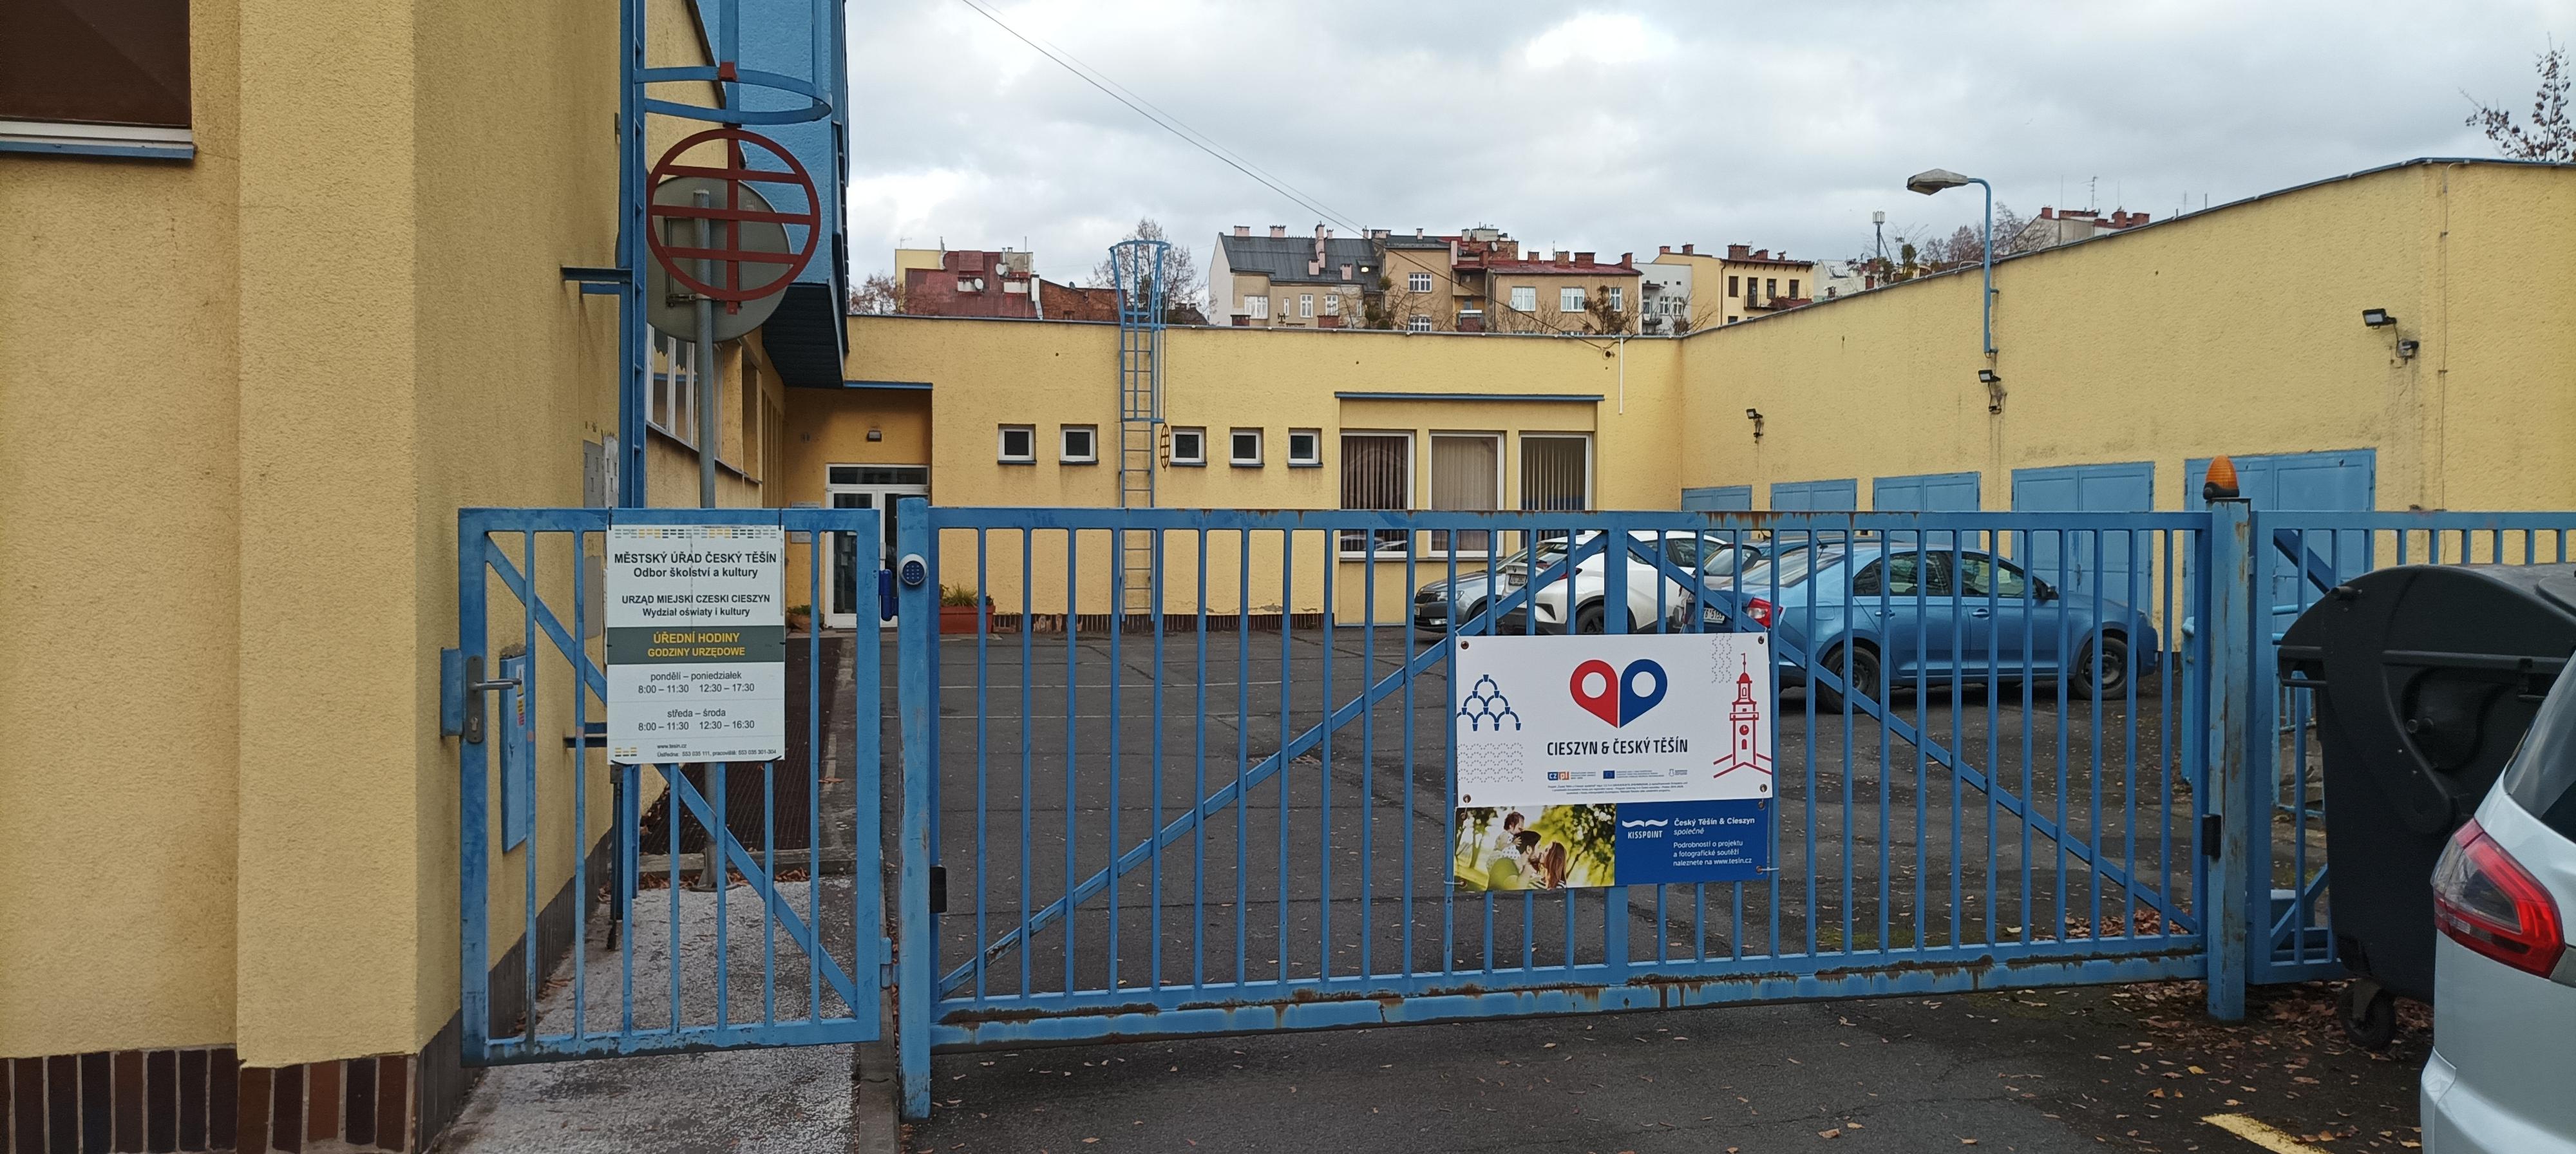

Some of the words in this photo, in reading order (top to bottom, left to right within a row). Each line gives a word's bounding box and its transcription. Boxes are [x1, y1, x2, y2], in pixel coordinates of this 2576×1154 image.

[614, 551, 667, 563] MĚSTSKÝ
[671, 551, 702, 563] ÚŘAD
[705, 551, 742, 563] ČESKÝ
[746, 551, 777, 563] TĚŠÍN
[634, 567, 667, 577] Odbor
[670, 567, 710, 577] školství
[723, 567, 758, 578] kultury
[622, 595, 654, 605] URZĄD
[657, 595, 693, 603] MIEJSKI
[696, 594, 729, 603] CZESKI
[732, 594, 770, 603] CIESZYN
[643, 607, 677, 618] Wydział
[679, 608, 712, 617] oświaty
[720, 607, 750, 617] kultury
[654, 630, 695, 643] ÚŘEDNÍ
[698, 632, 739, 643] HODINY
[648, 648, 689, 657] GODZINY
[692, 647, 745, 657] URZĘDOWE
[651, 672, 681, 682] pondělí
[691, 671, 742, 681] poniedziałek
[638, 685, 656, 694] 8:00
[667, 685, 688, 693] 11:30
[699, 684, 722, 693] 12:30
[667, 709, 693, 717] středa
[703, 708, 726, 717] środa
[638, 723, 656, 731] 8:00
[667, 722, 688, 730] 11:30
[699, 721, 722, 730] 12:30
[732, 721, 754, 729] 16:30
[1547, 741, 1598, 756] CIESZYN
[1601, 742, 1609, 755] &
[1613, 736, 1651, 755] ČESKÝ
[1653, 736, 1688, 753] TĚŠÍN
[1674, 818, 1696, 826] Český
[1628, 831, 1663, 839] KISSPOINT
